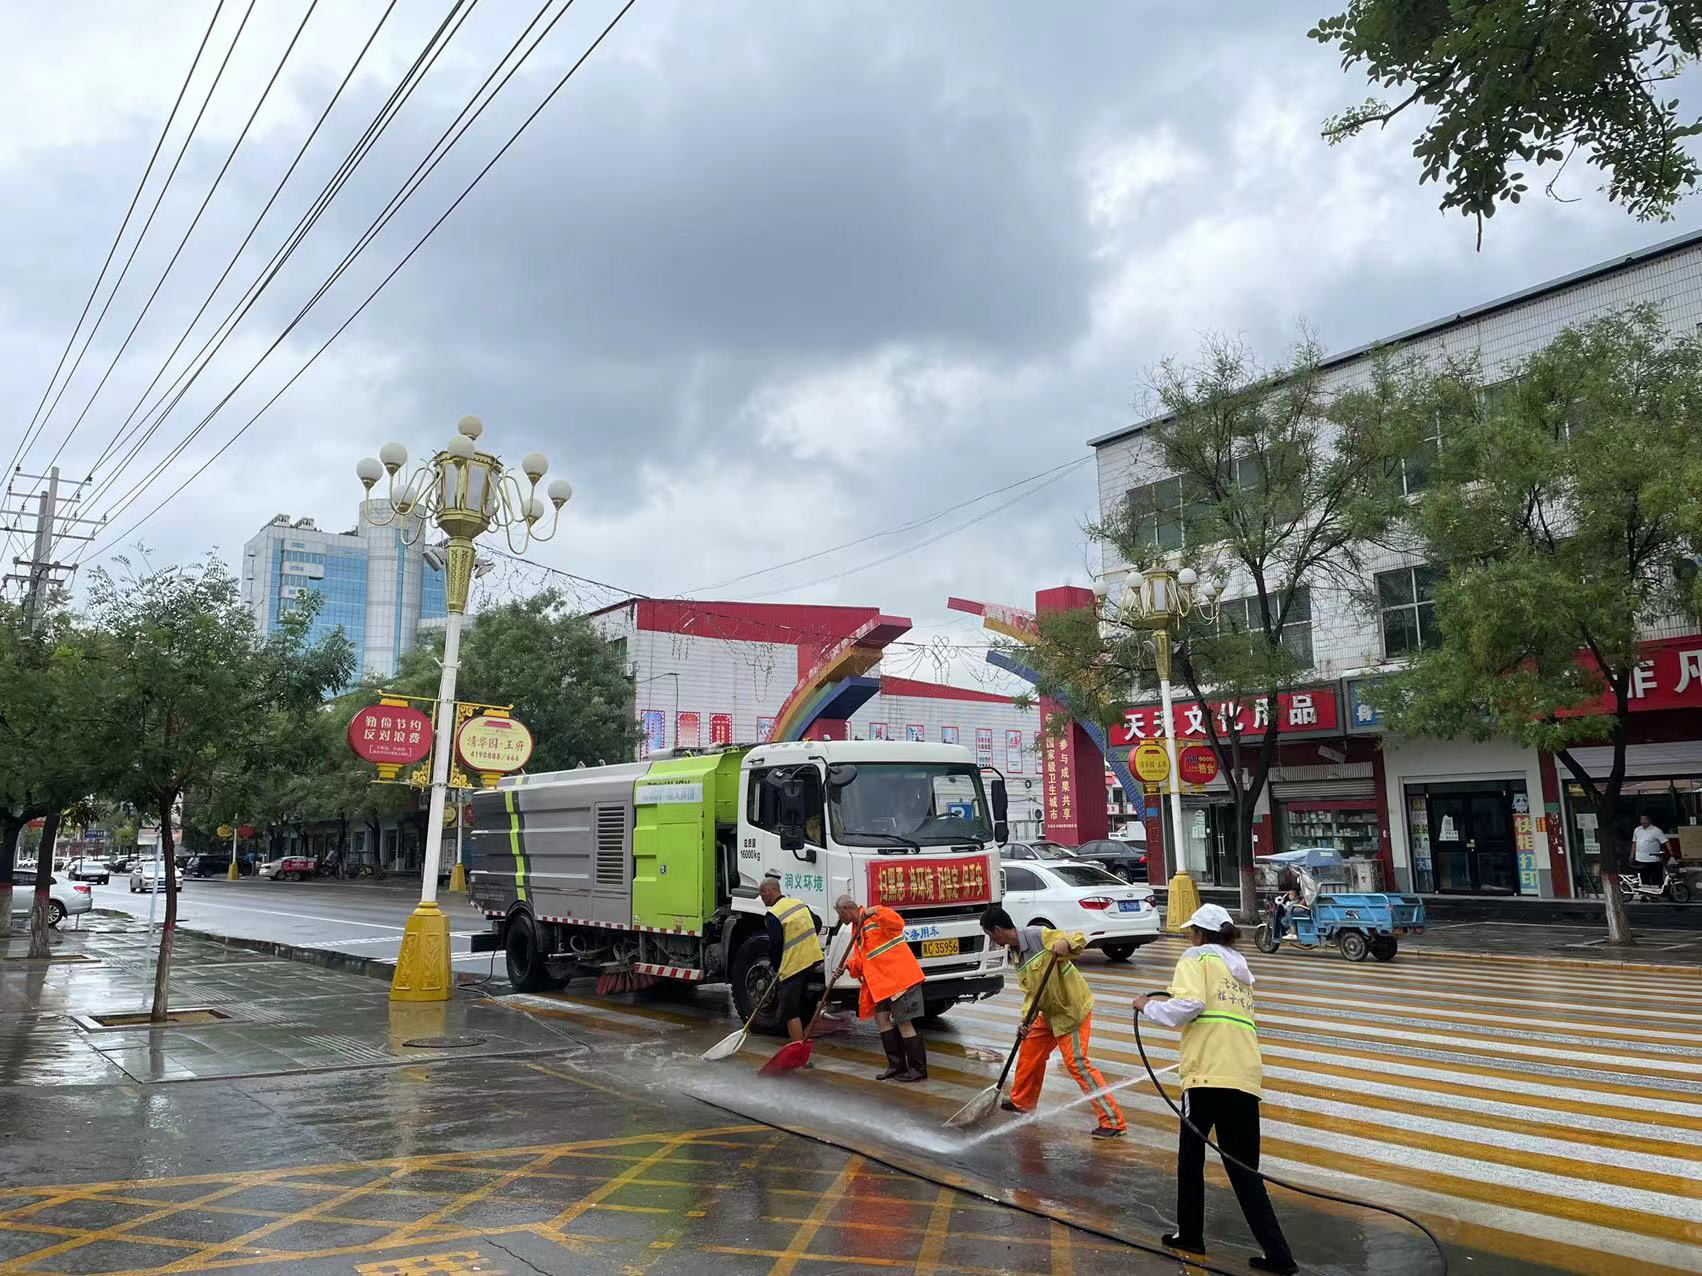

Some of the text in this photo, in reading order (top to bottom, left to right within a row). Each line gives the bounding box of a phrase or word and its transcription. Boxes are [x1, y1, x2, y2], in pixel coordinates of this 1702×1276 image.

[365, 716, 421, 731] 勤俭节约
[364, 729, 420, 744] 反对浪费
[785, 872, 824, 892] 润义环境
